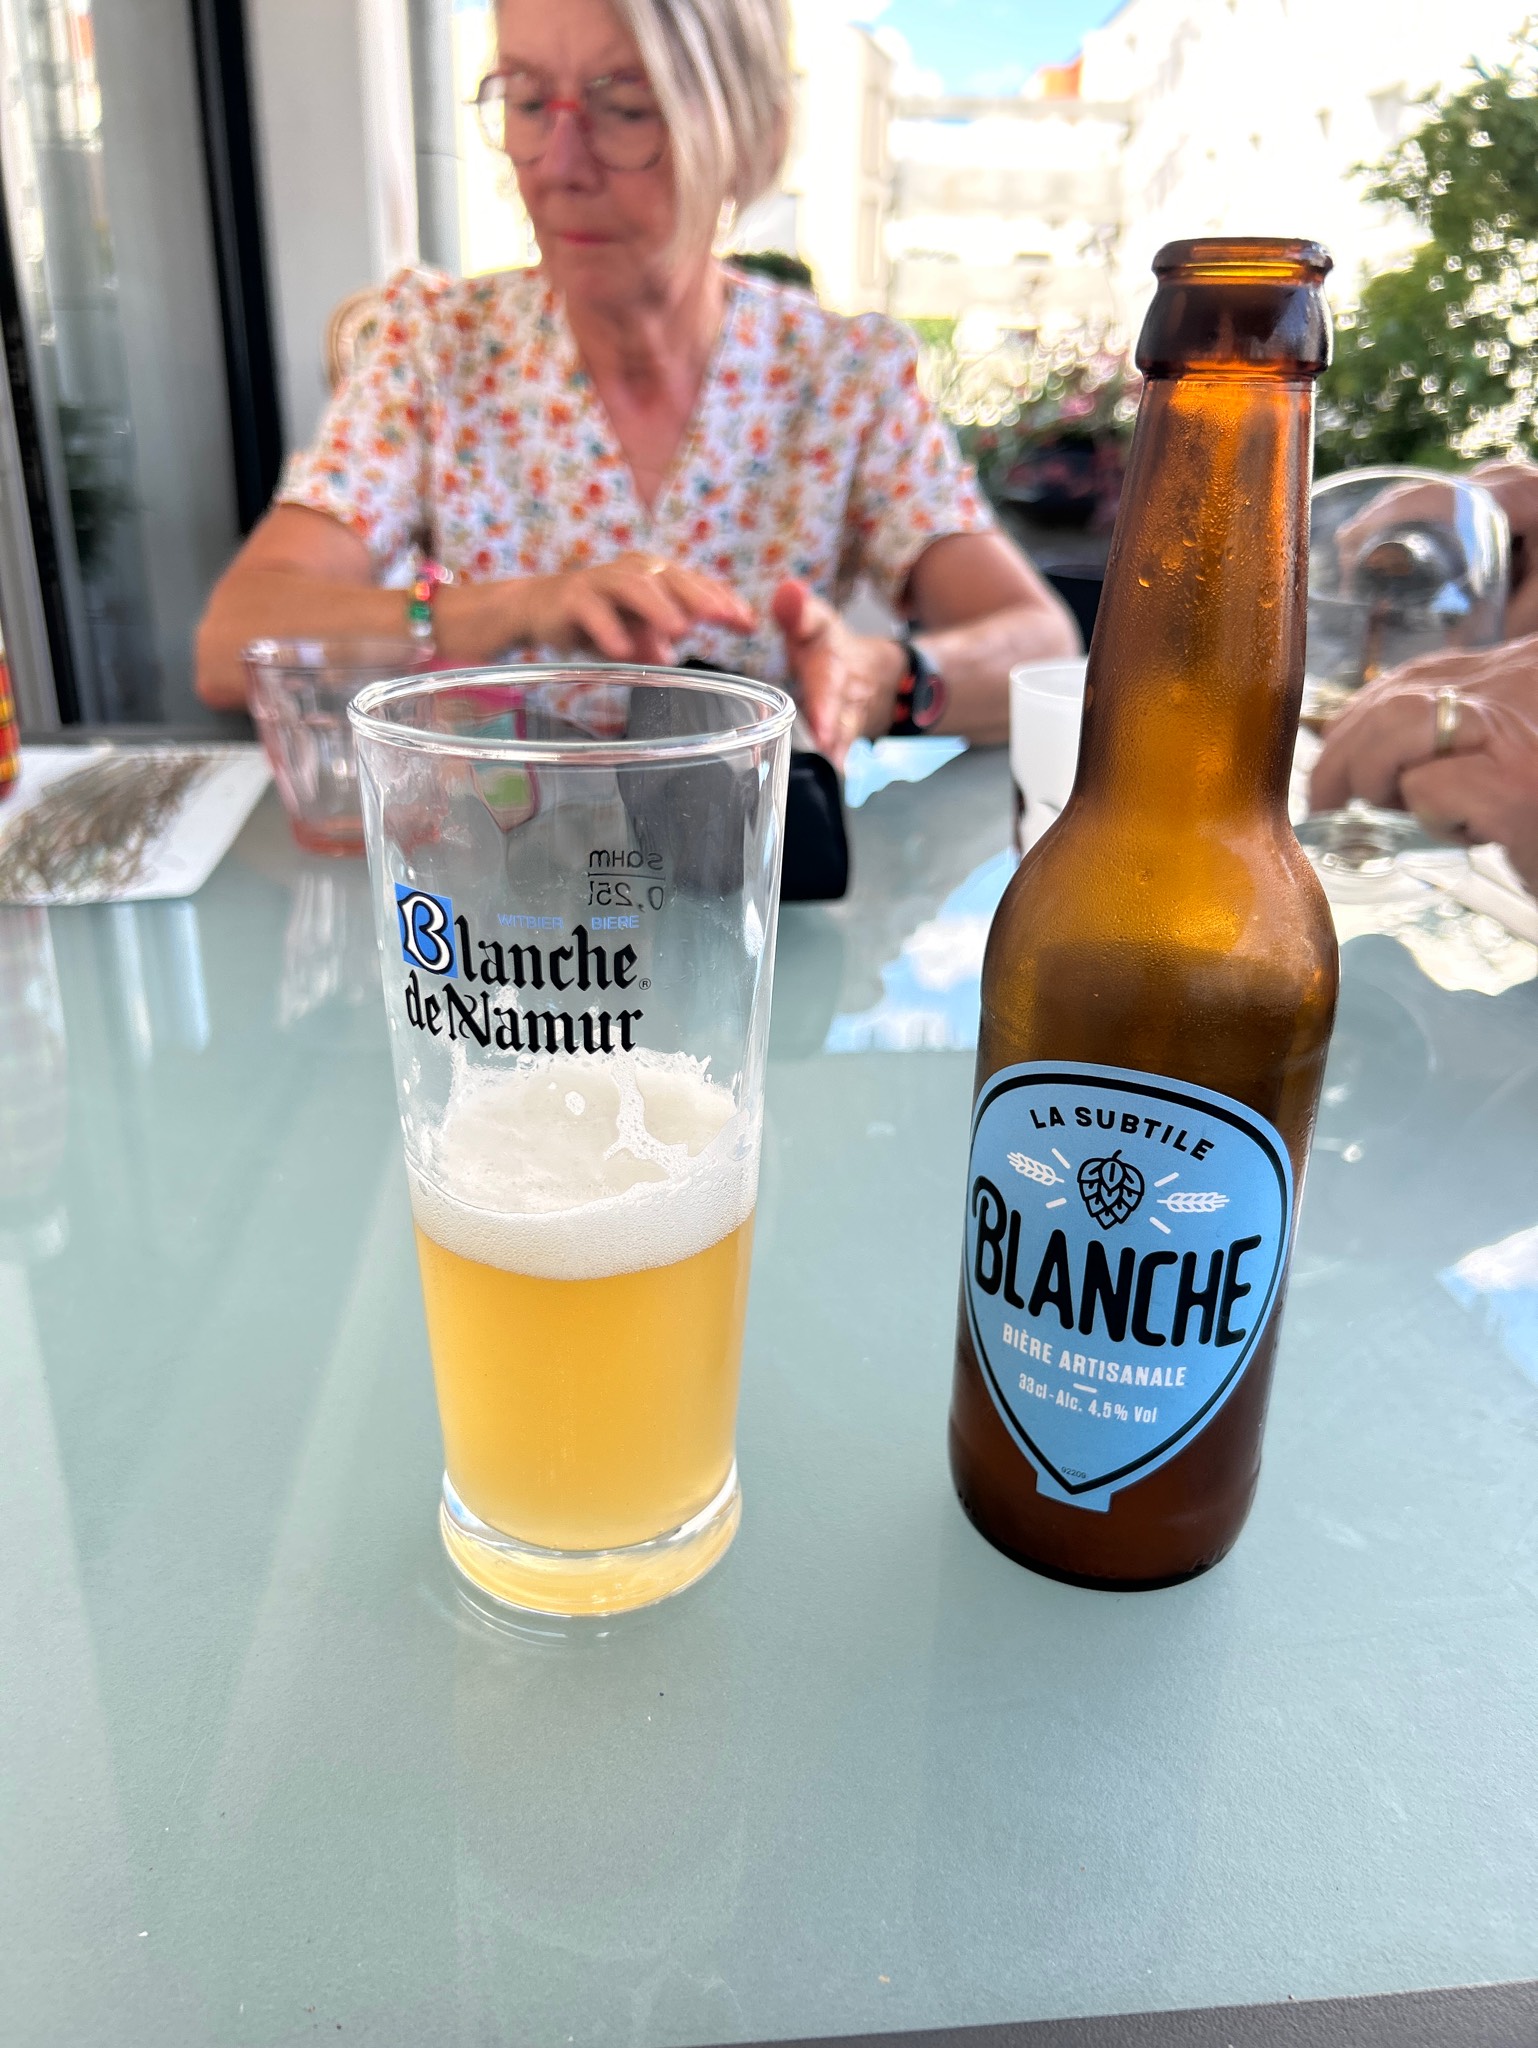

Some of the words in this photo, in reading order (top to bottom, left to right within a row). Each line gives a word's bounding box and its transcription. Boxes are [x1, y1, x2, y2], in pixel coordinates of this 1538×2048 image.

[397, 891, 638, 992] Blanche
[497, 913, 564, 930] WITBIER
[591, 915, 640, 930] BIERE
[404, 969, 443, 1036] de
[442, 982, 644, 1055] Namur
[1030, 1106, 1066, 1129] LA
[1074, 1106, 1215, 1161] SUBTILE
[972, 1175, 1262, 1347] BLANCHE
[1002, 1323, 1053, 1364] BIÈRE
[1058, 1350, 1187, 1387] ARTISANALE
[1134, 1406, 1157, 1423] Vol
